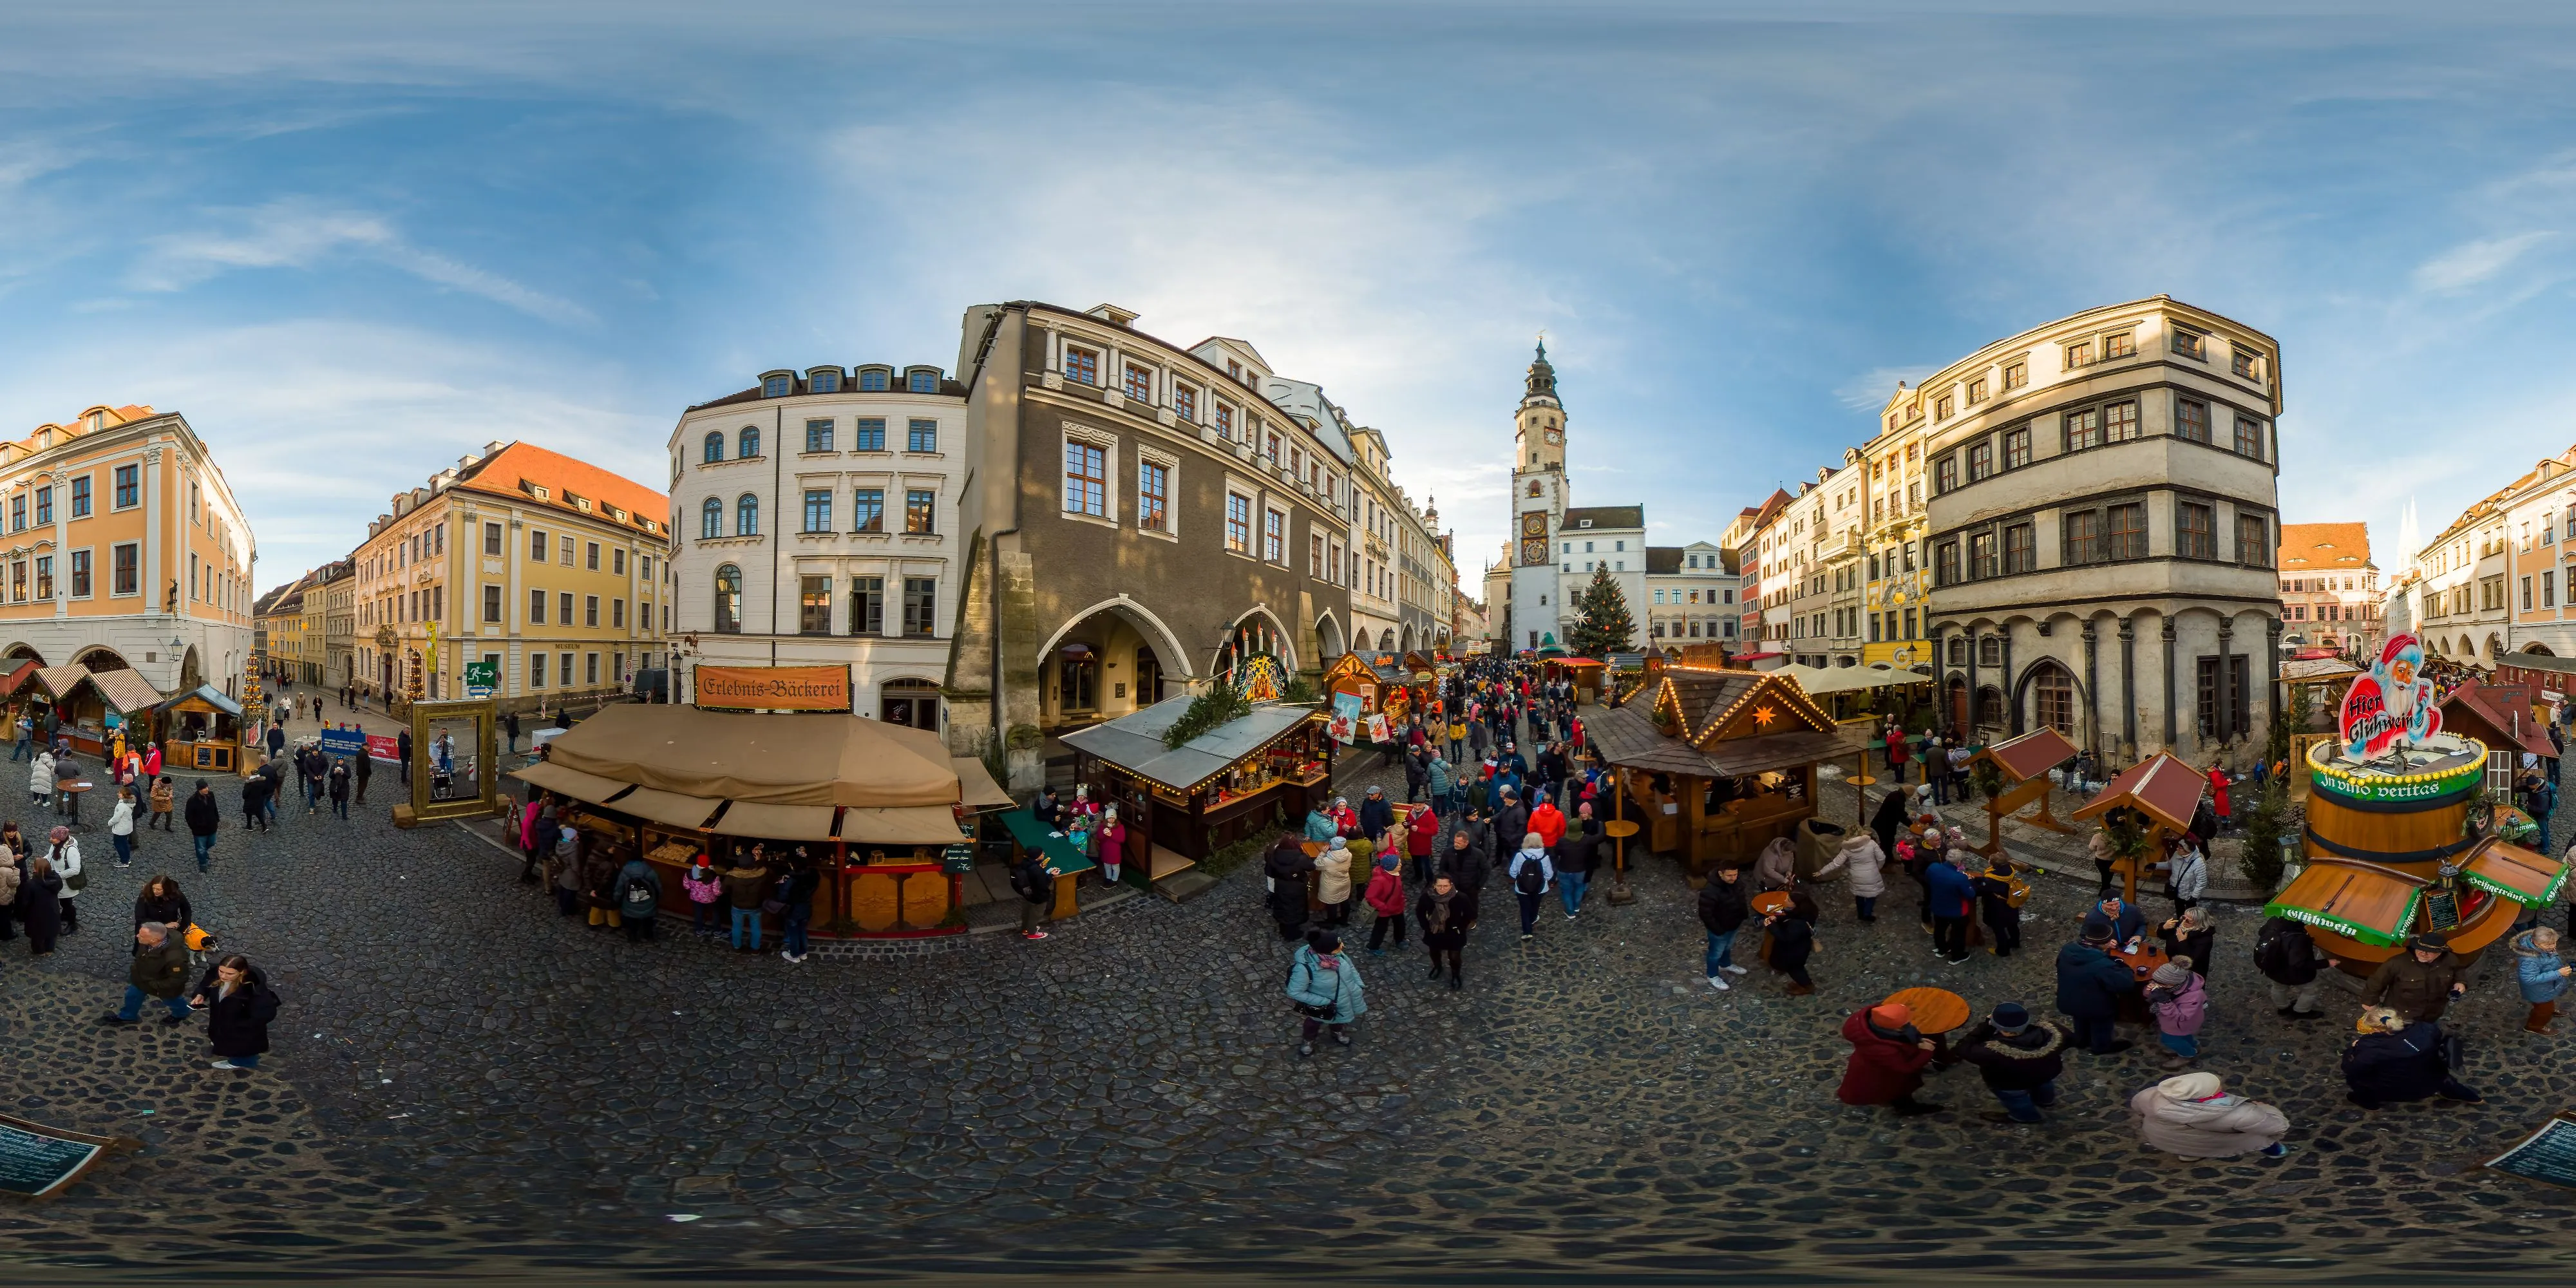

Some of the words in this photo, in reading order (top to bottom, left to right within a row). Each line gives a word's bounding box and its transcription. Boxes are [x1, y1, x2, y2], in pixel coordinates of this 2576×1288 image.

[703, 677, 840, 698] Erlebnis-Bäckerei
[2349, 694, 2382, 718] Hier
[2349, 713, 2414, 742] Glühwein
[2338, 780, 2371, 795] vino
[2377, 781, 2440, 797] veritas
[2468, 876, 2528, 904] Heißgetränke
[2287, 909, 2357, 936] Glühwein
[2399, 893, 2422, 939] Heißgetränke
